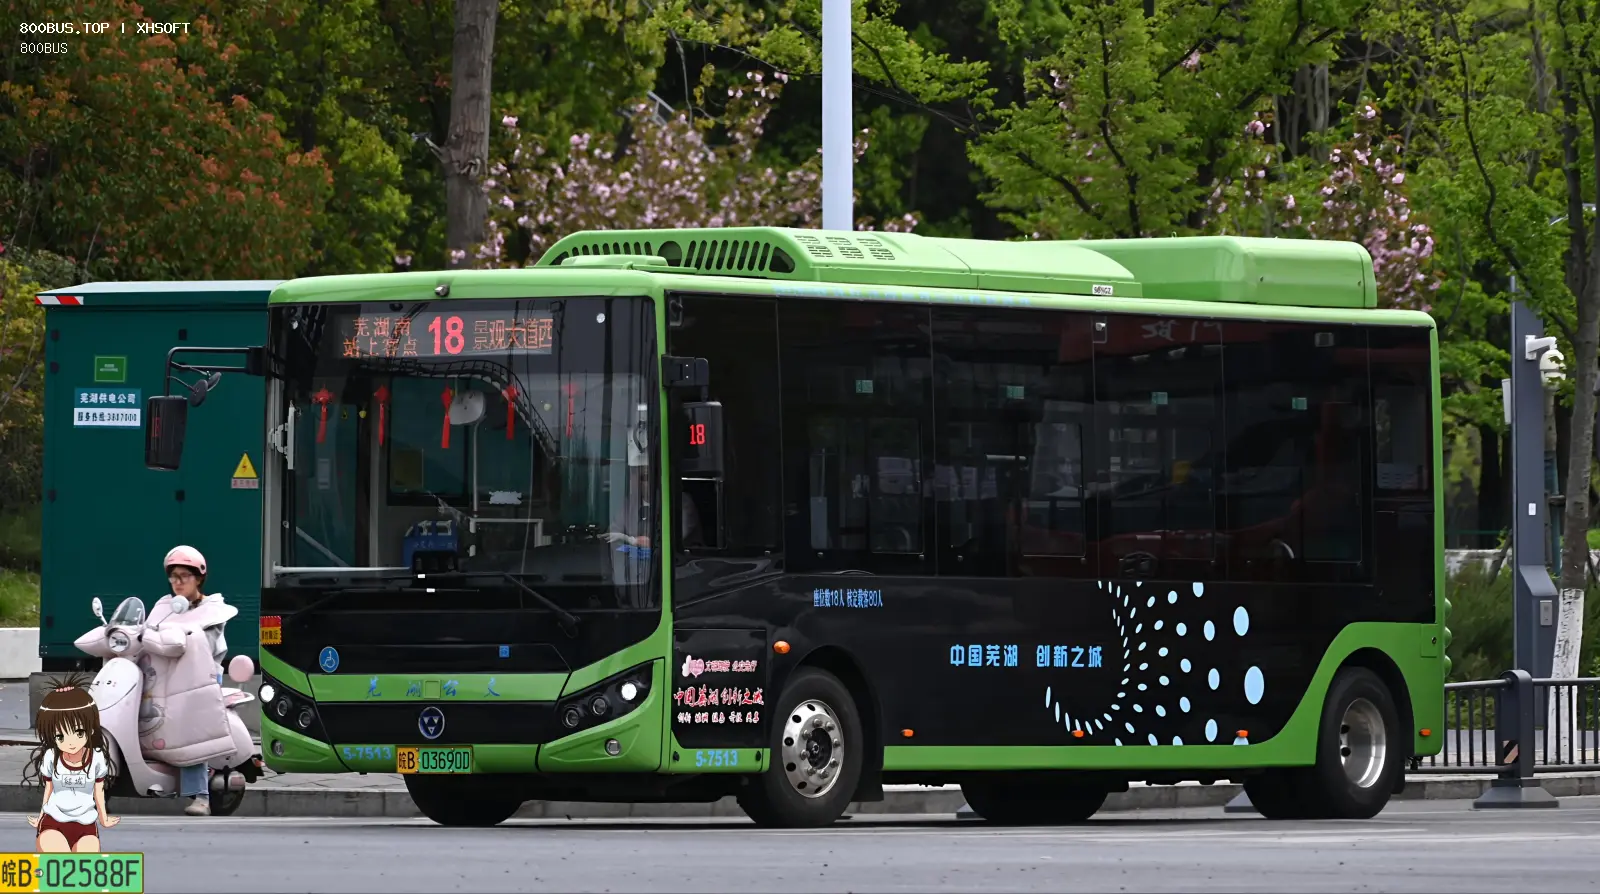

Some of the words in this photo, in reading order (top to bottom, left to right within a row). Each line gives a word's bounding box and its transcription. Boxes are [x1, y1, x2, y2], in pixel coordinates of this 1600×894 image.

[353, 317, 412, 337] 芜湖南
[428, 316, 465, 355] 18
[473, 318, 553, 350] 景观大道西
[343, 337, 419, 358] 站上客点
[80, 392, 136, 404] 芜湖供电公司
[689, 424, 706, 445] 18
[950, 644, 1018, 667] 中国芜湖
[1036, 645, 1102, 668] 创新之城
[343, 746, 392, 761] 5-7513
[695, 750, 738, 767] 5-7513
